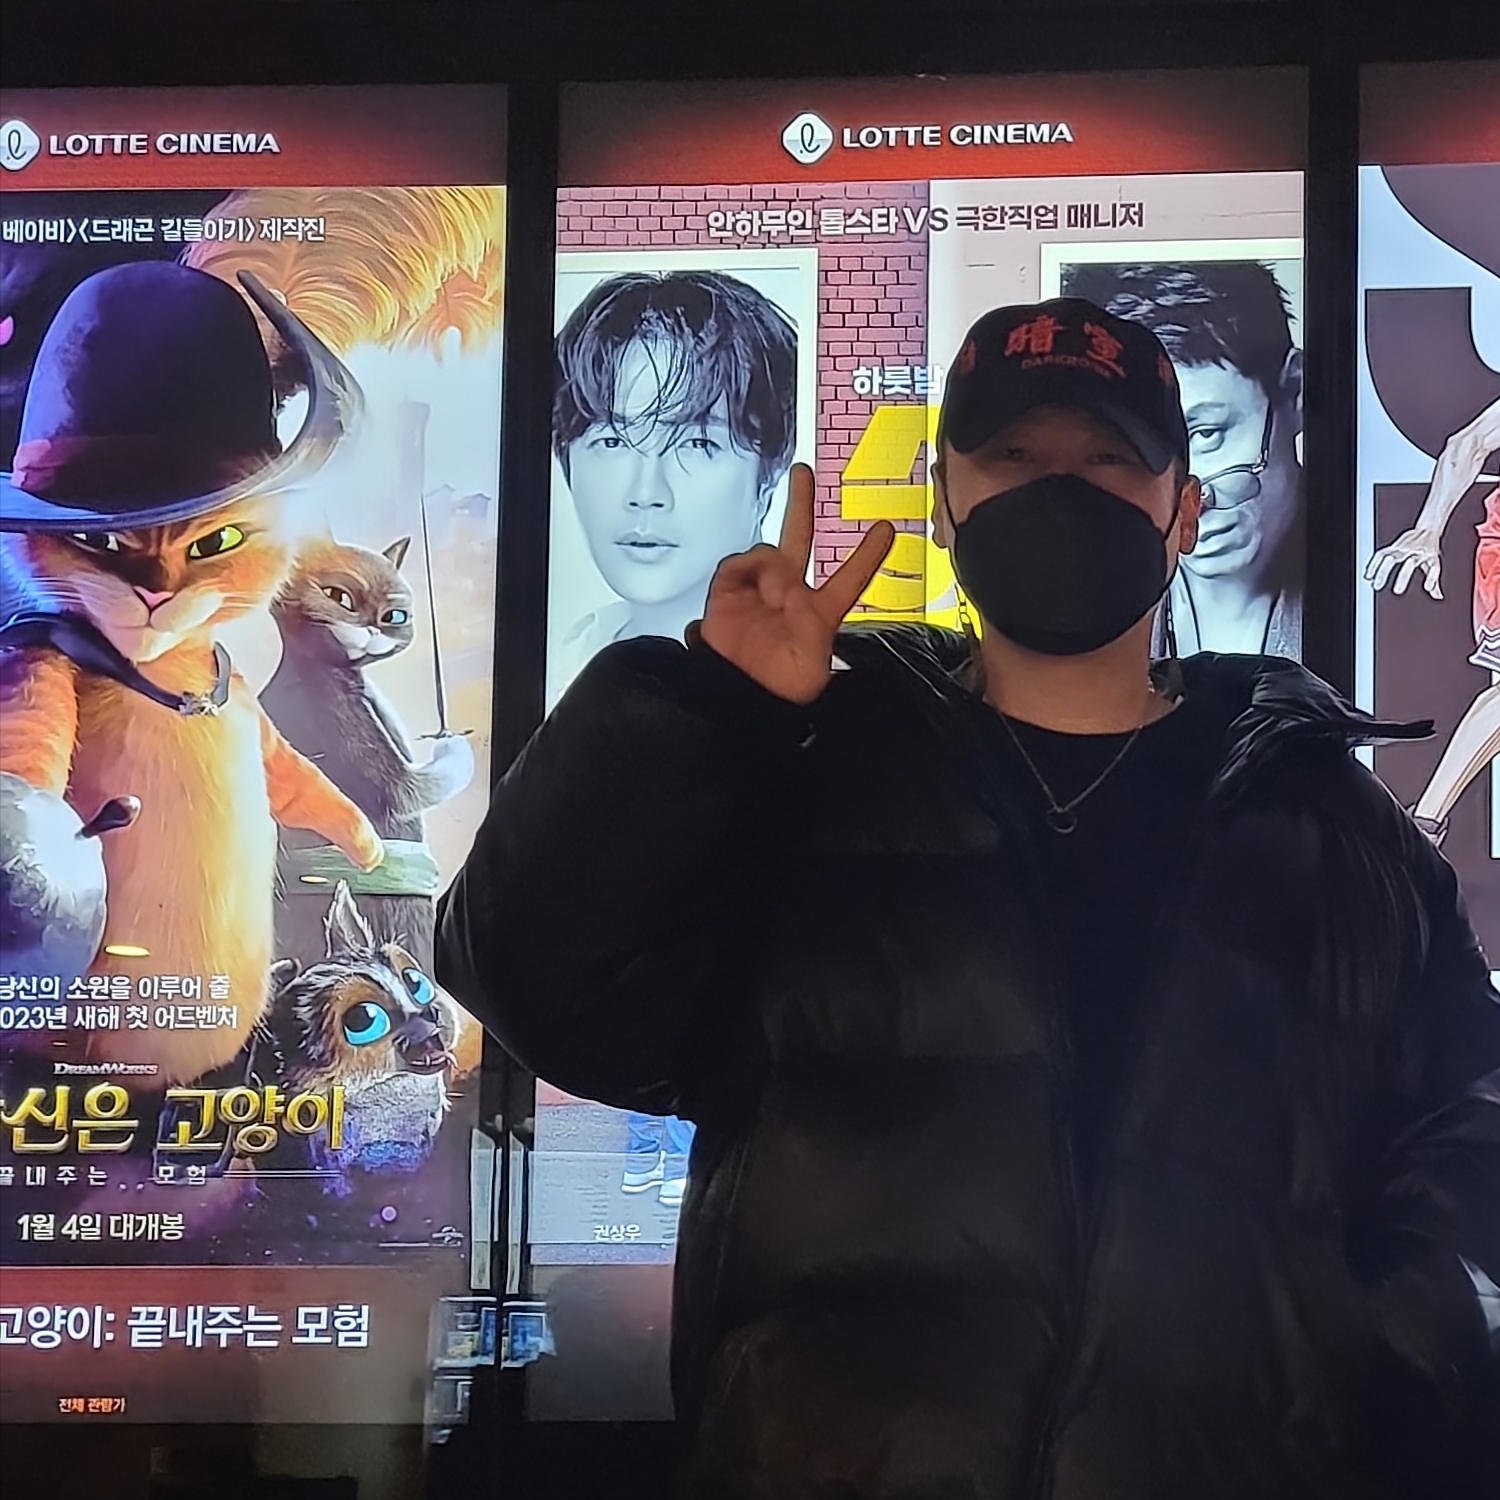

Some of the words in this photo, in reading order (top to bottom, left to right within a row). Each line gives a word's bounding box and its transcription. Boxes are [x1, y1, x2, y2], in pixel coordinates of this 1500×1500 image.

[49, 133, 148, 155] LOTTE
[156, 132, 281, 154] CINEMA
[843, 126, 941, 149] LOTTE
[949, 121, 1074, 146] CINEMA
[259, 216, 325, 242] 제작진
[707, 208, 813, 237] 안하무인
[819, 206, 898, 235] 톱스타
[903, 207, 949, 234] VS
[955, 203, 1058, 232] 극한직업
[1065, 201, 1145, 230] 매니저
[851, 364, 944, 396] 하룻밤
[0, 975, 60, 1000] 당신의
[66, 975, 132, 1000] 소원을
[138, 974, 202, 1000] 이루어
[208, 974, 231, 1000] 줄
[73, 1005, 119, 1030] 새해
[125, 1005, 148, 1030] 첫
[154, 1005, 238, 1030] 어드벤처
[156, 1084, 346, 1156] 고양이
[155, 1164, 207, 1186] 모험
[17, 1213, 55, 1241] 1월
[61, 1213, 101, 1241] 4일
[109, 1213, 186, 1241] 대개봉
[593, 1223, 643, 1242] 권상우
[126, 1304, 284, 1349] 끝내주는
[291, 1303, 371, 1349] 모험
[59, 1397, 86, 1414] 전체
